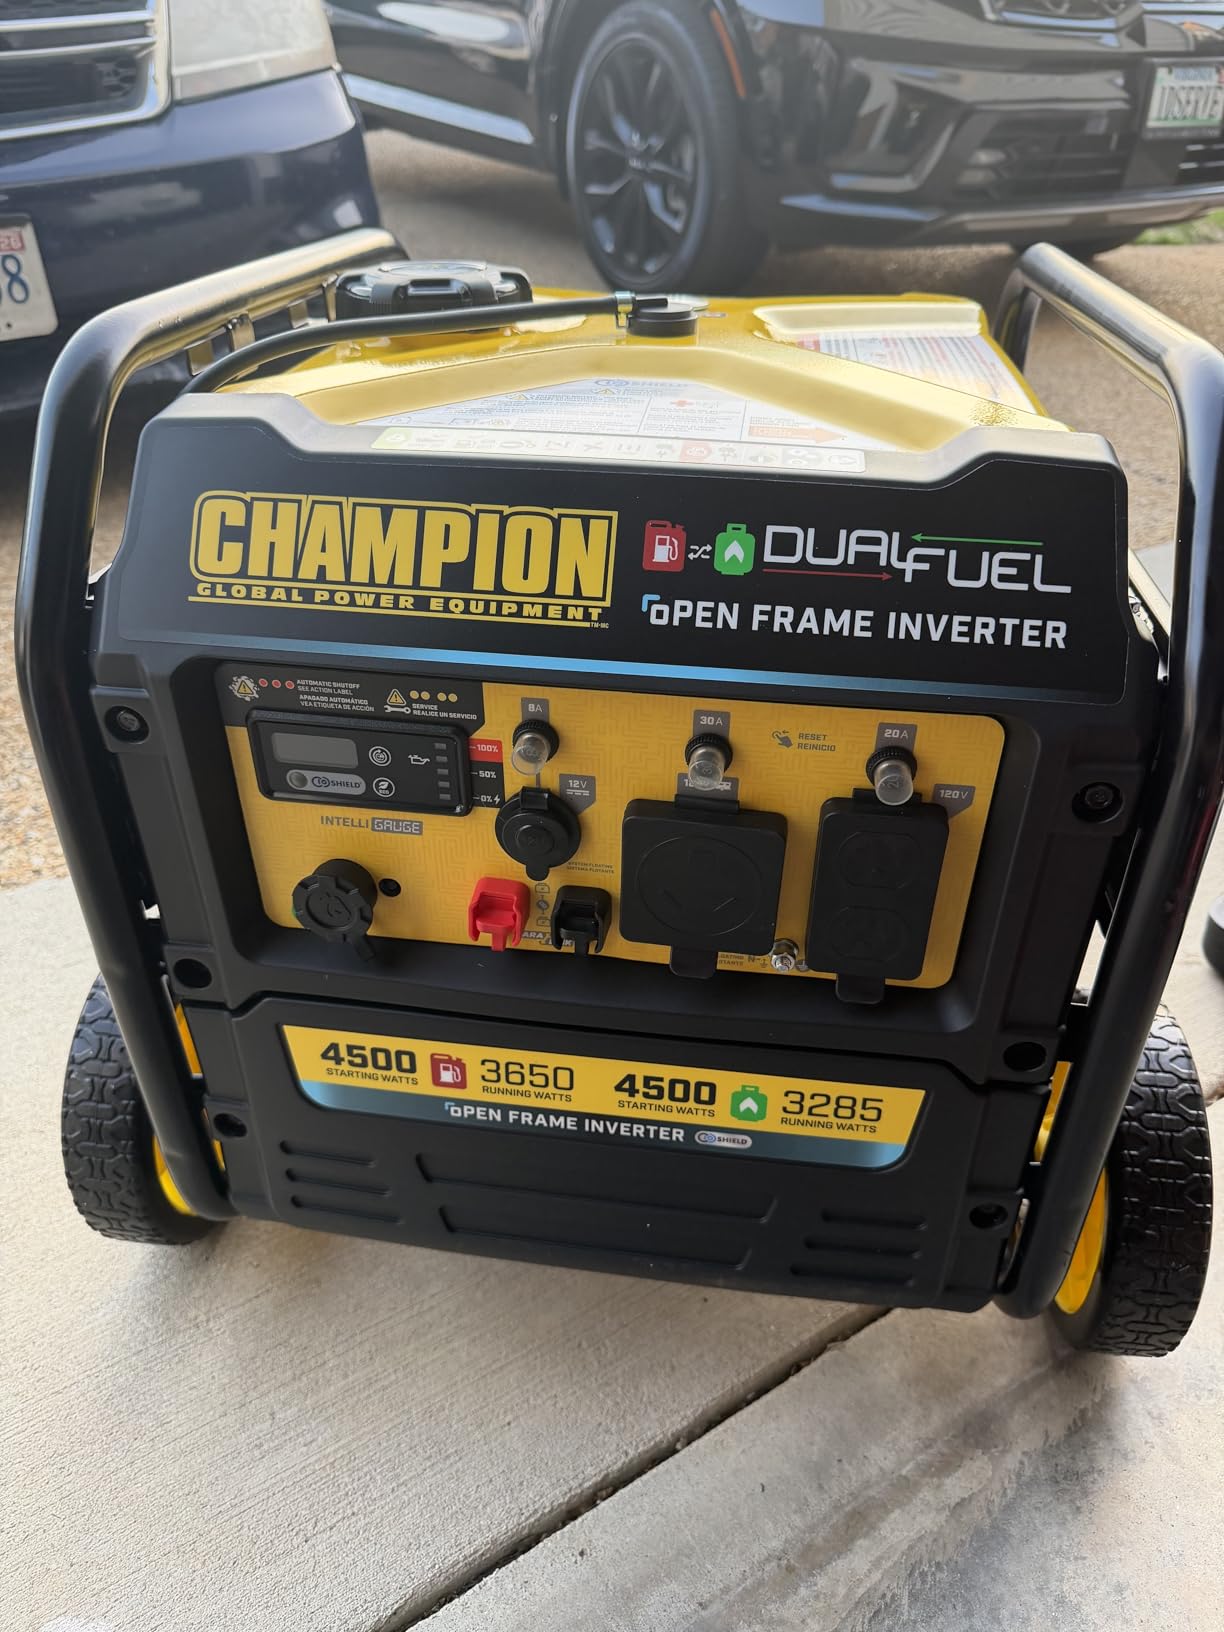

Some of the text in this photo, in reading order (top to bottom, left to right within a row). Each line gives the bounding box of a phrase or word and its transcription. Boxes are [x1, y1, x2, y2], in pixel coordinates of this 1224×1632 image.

[0, 254, 29, 304] 8
[197, 498, 610, 598] CHAMPION
[197, 582, 603, 621] GLOBAL POWER EQUIPMENT
[647, 598, 1068, 649] OPEN FRAME INVERTER
[297, 679, 361, 689] AUTOMATIC SHUTOFF
[299, 694, 329, 702] APAGADO
[313, 702, 343, 710] ETIQUETA
[798, 732, 827, 742] RESET
[477, 744, 499, 753] 100%
[797, 742, 836, 752] REINICIO
[479, 770, 497, 779] 50%
[331, 779, 361, 789] SHIELD
[480, 794, 493, 803] 0%
[320, 815, 421, 834] INTELLI GAUGE
[521, 930, 545, 940] ARA
[320, 1041, 418, 1075] 4500
[325, 1066, 419, 1086] STARTING WATTS
[480, 1058, 575, 1092] 3650
[482, 1085, 573, 1103] RUNNING WATTS
[613, 1072, 718, 1106] 4500
[617, 1099, 716, 1118] STARTING WATTS
[781, 1089, 884, 1123] 3285
[448, 1103, 686, 1143] OPEN FRAME INVERTER
[780, 1116, 878, 1134] RUNNING WATTS
[716, 1135, 749, 1146] SHIELD
